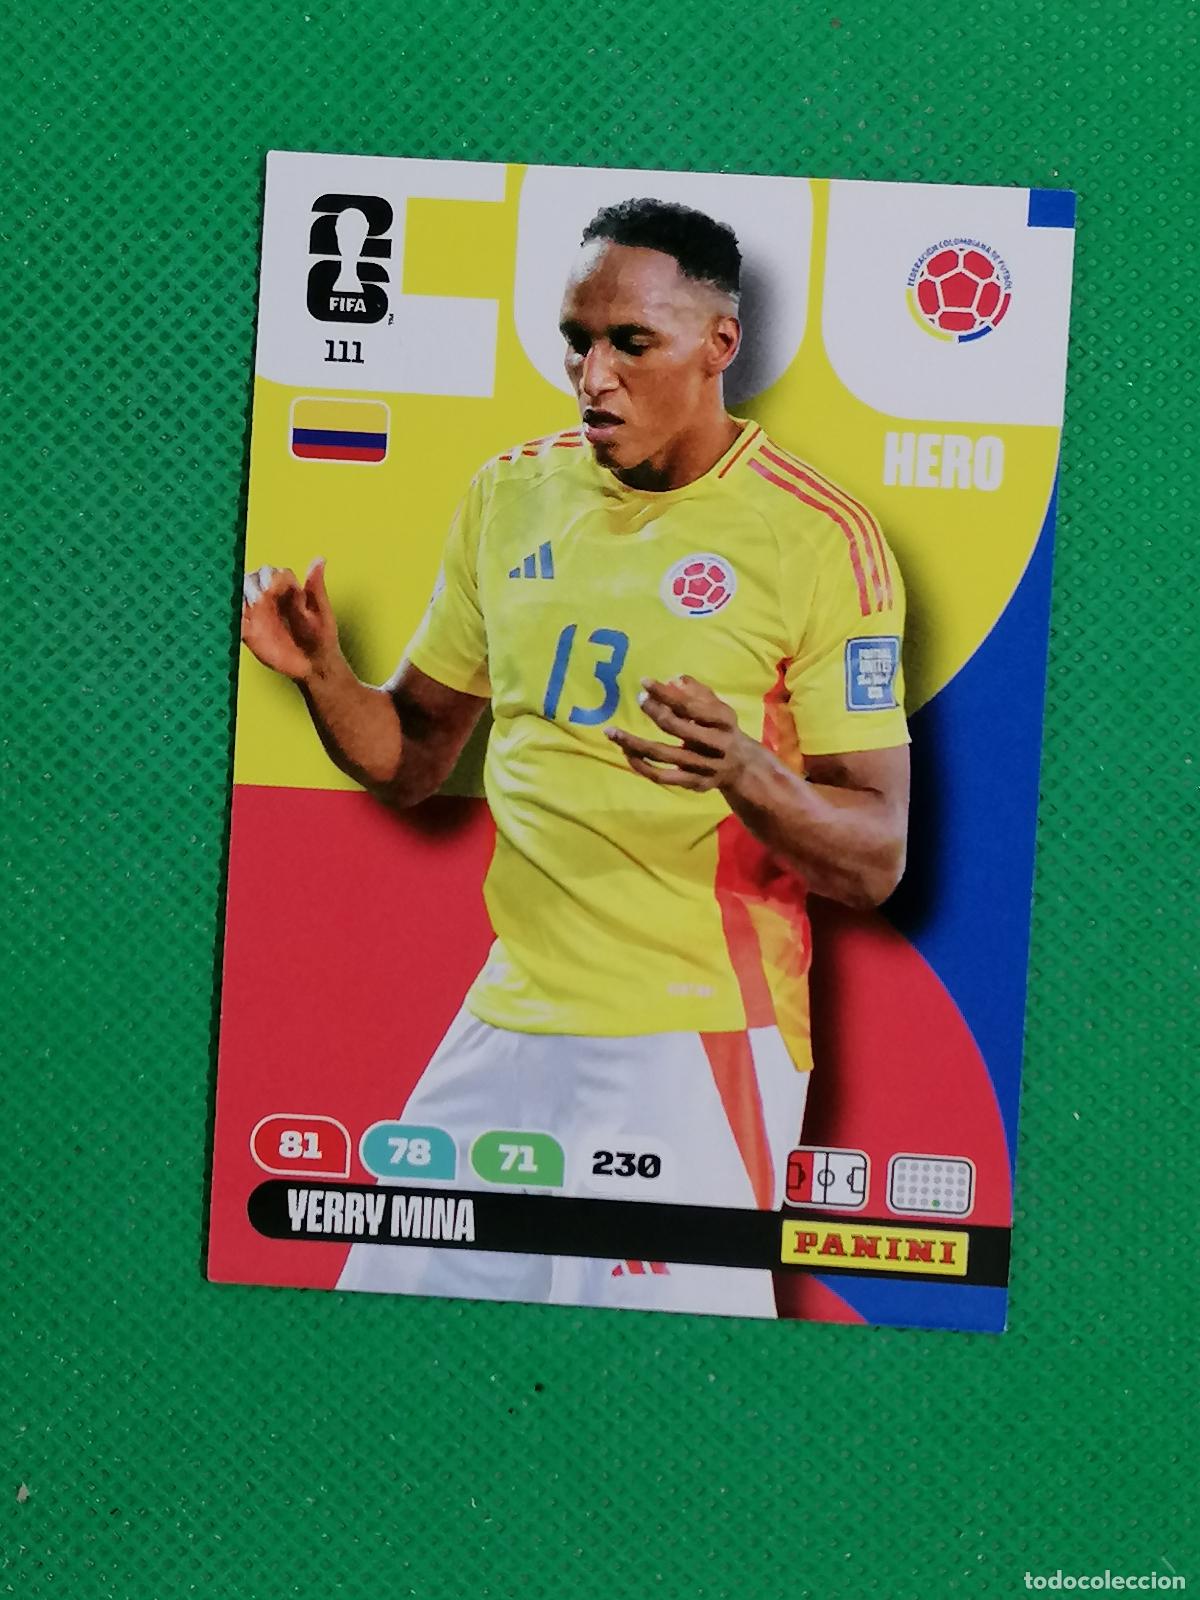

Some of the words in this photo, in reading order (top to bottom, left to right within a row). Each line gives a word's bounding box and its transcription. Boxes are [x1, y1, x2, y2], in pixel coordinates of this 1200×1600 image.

[329, 297, 367, 313] FIFA
[324, 339, 365, 364] 111
[883, 431, 1005, 492] HERO
[543, 623, 630, 726] 13
[278, 1130, 323, 1160] 81
[387, 1137, 431, 1167] 78
[498, 1143, 538, 1173] 71
[592, 1150, 661, 1179] 230
[287, 1188, 387, 1236] YERRY
[390, 1195, 476, 1242] MINA
[793, 1230, 957, 1265] PANINI
